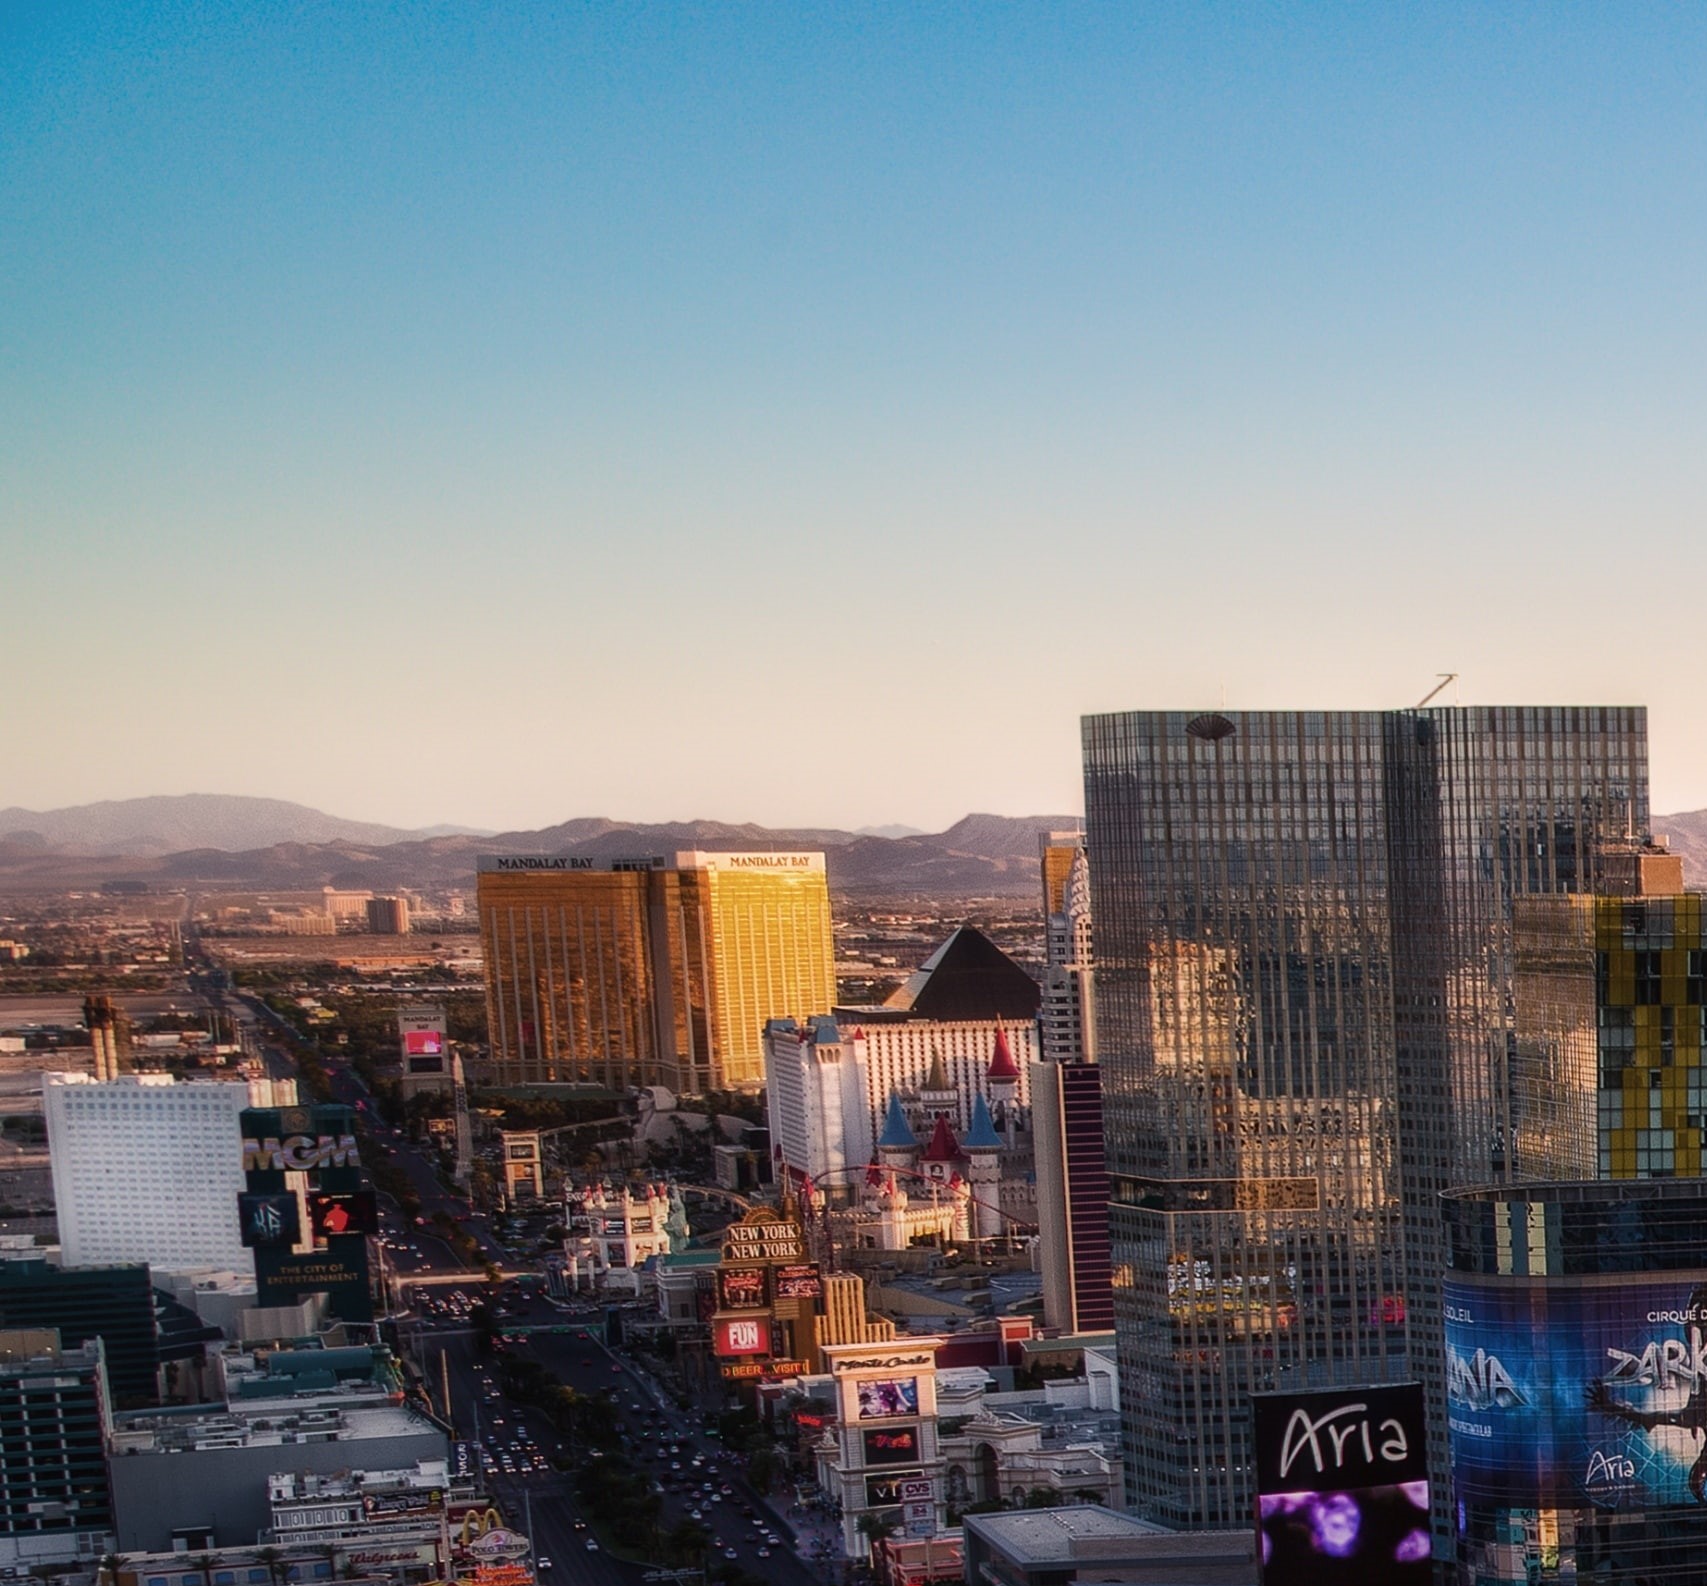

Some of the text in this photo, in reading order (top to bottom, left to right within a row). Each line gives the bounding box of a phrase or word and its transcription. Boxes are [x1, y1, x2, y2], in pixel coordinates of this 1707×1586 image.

[498, 857, 594, 870] MANDALAY BAY
[730, 855, 810, 868] MANDALAY BAY
[242, 1134, 362, 1171] MGM
[730, 1223, 797, 1242] NEW YORK
[731, 1241, 798, 1260] NEW YORK
[280, 1263, 345, 1275] THE CITY OF
[266, 1272, 360, 1285] ENTERTAINMENT
[1646, 1308, 1697, 1325] CIRQUE
[729, 1326, 758, 1347] FUN
[836, 1354, 931, 1371] Monte Carlo
[1280, 1403, 1408, 1479] Aria
[1585, 1451, 1635, 1485] Aria
[905, 1482, 930, 1494] CVS
[348, 1551, 421, 1566] Walgreens
